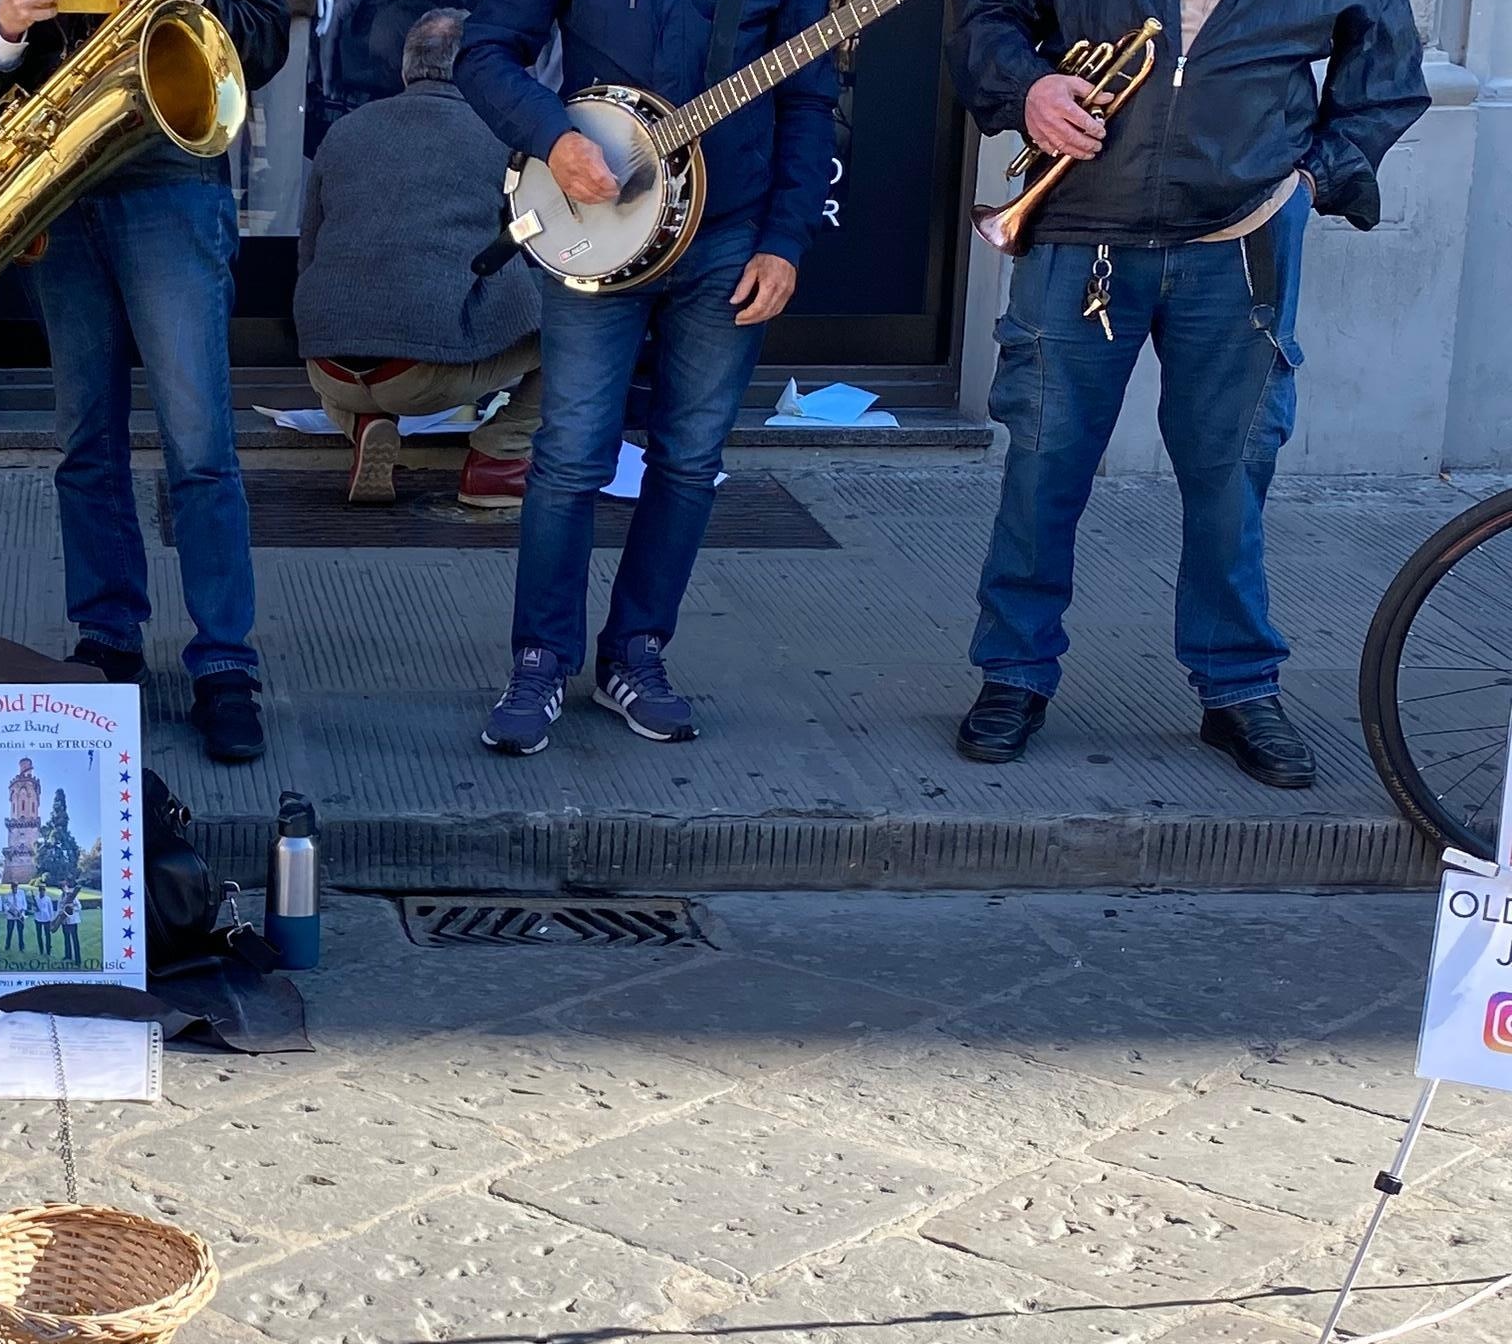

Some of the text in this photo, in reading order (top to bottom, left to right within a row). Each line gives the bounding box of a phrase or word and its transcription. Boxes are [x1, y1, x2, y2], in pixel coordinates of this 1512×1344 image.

[31, 693, 119, 733] Florence
[24, 720, 60, 735] Band
[57, 740, 112, 749] ETRUSCO
